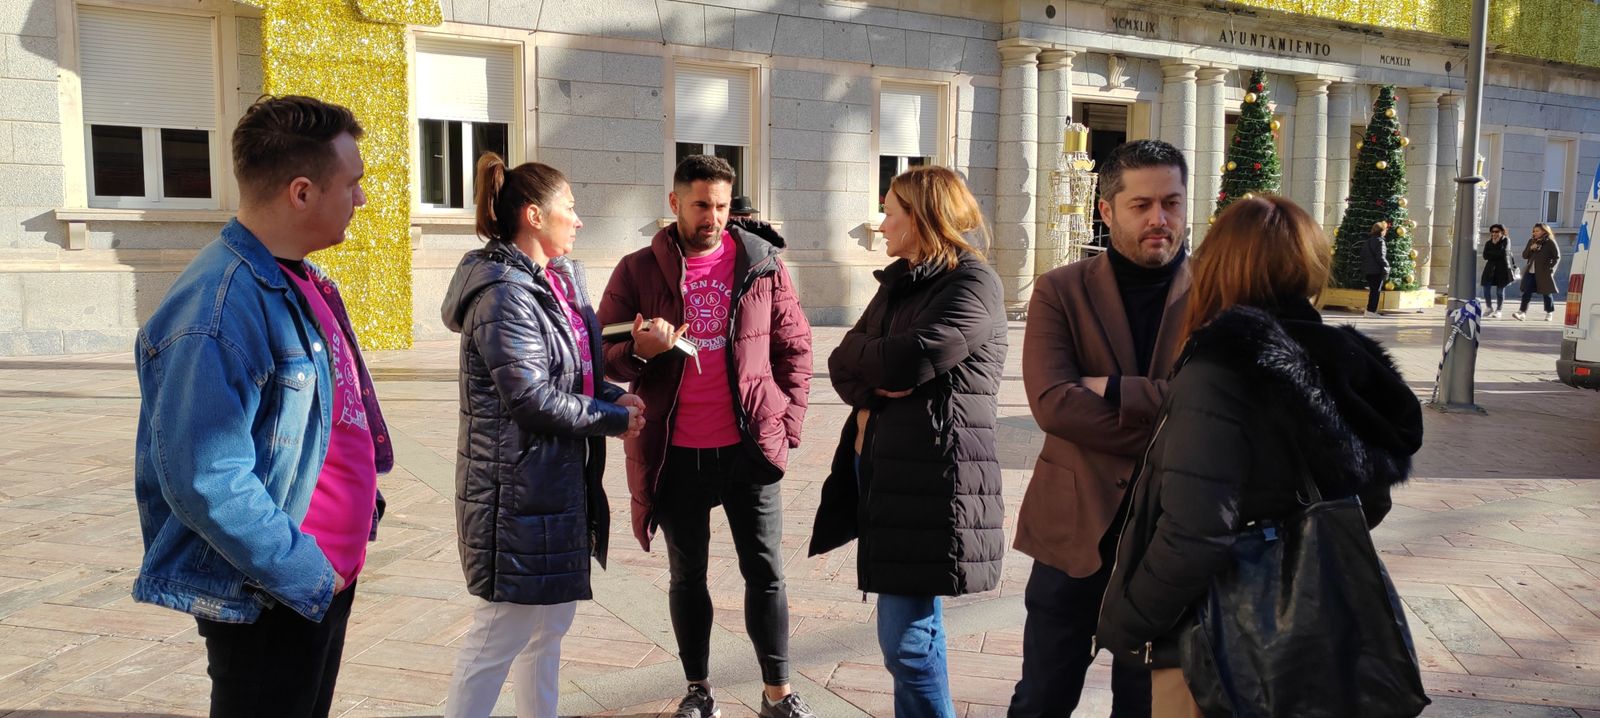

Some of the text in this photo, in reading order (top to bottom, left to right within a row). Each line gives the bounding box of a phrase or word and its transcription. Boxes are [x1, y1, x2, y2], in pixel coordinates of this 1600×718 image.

[1112, 17, 1155, 33] MCMXLIX
[1219, 29, 1331, 57] AYUNTAMIENTO
[1379, 54, 1411, 67] MCMXLIX
[689, 279, 708, 291] EN
[711, 279, 732, 298] LUC
